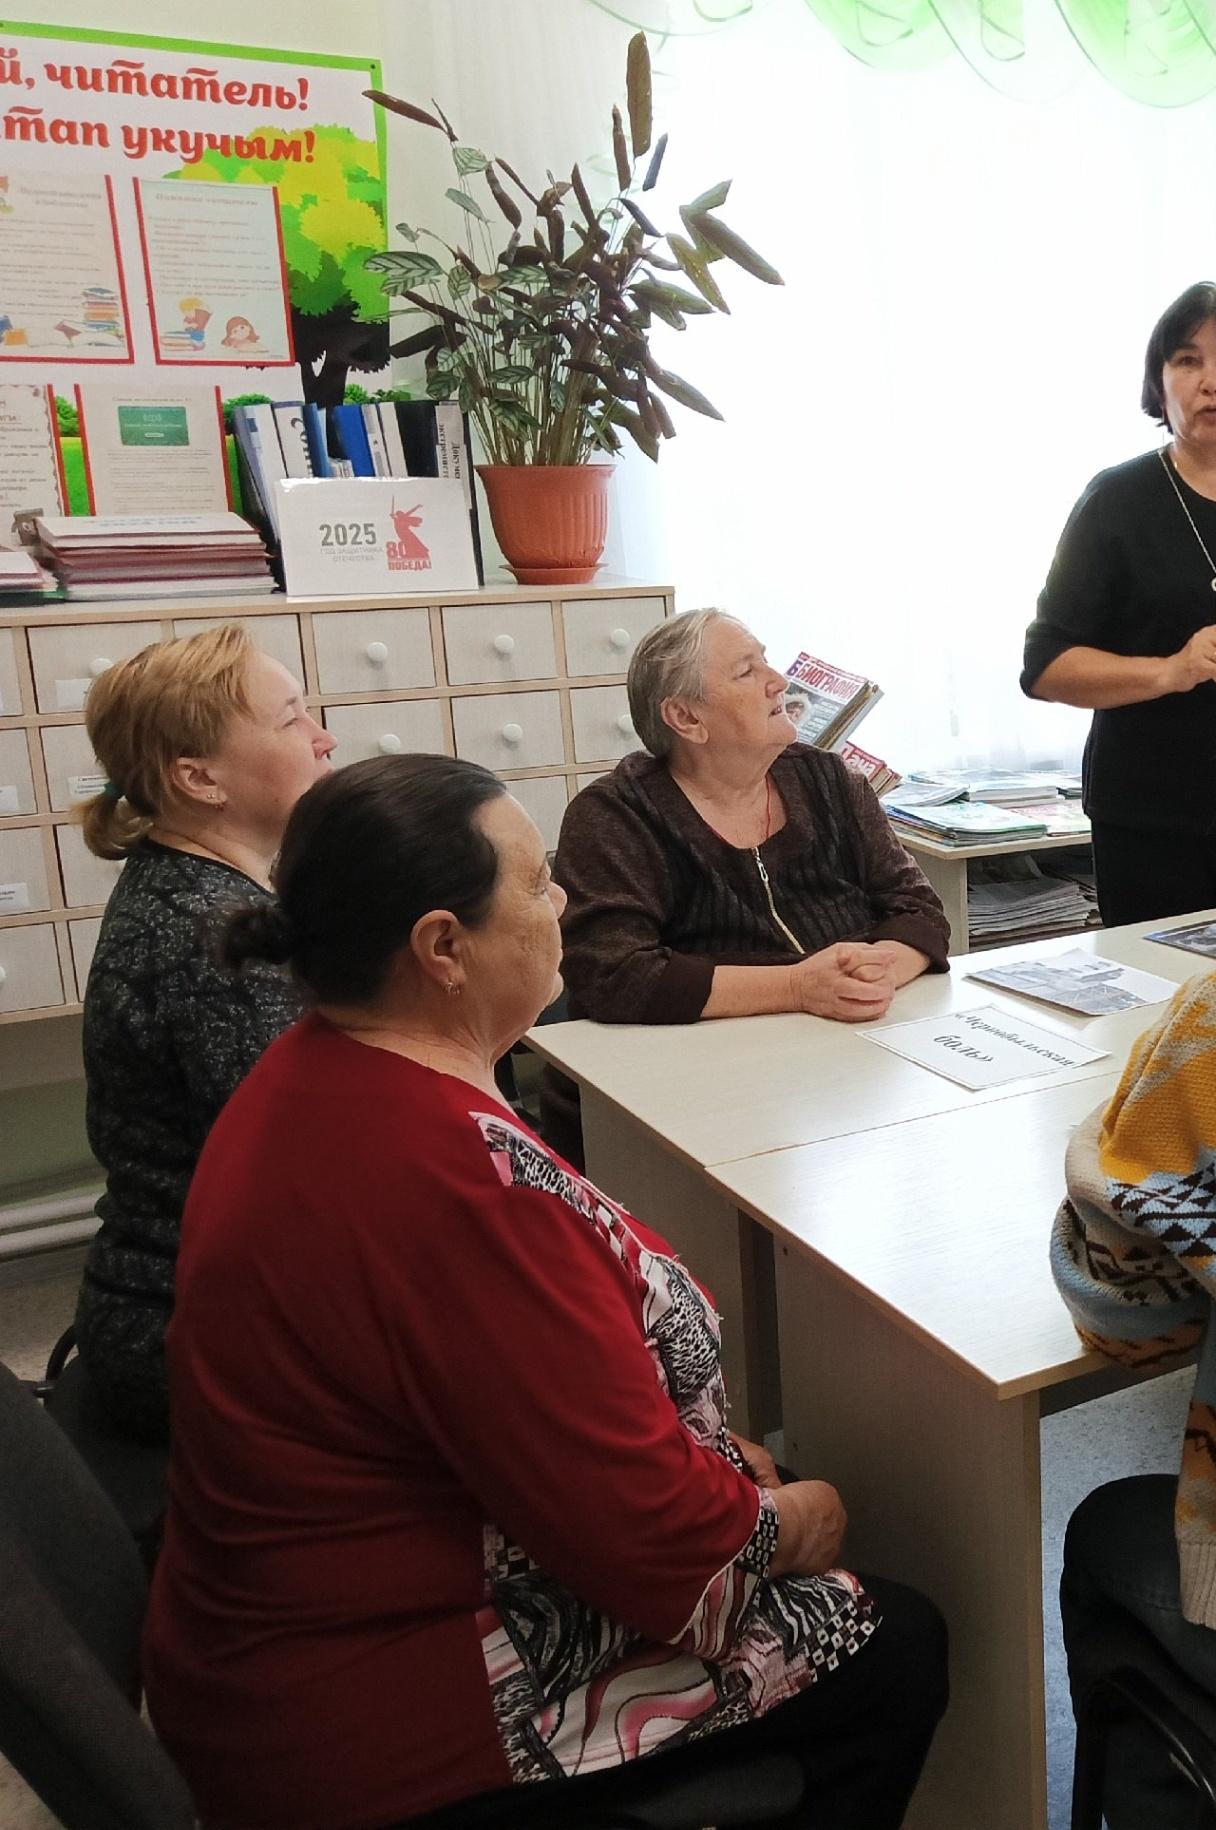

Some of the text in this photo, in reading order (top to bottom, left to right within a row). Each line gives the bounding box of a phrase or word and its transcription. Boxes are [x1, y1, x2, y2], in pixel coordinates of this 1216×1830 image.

[43, 59, 309, 111] читатель!
[0, 105, 316, 164] тап укучым!
[319, 523, 377, 547] 2025
[388, 560, 432, 571] ПОБЕДА!
